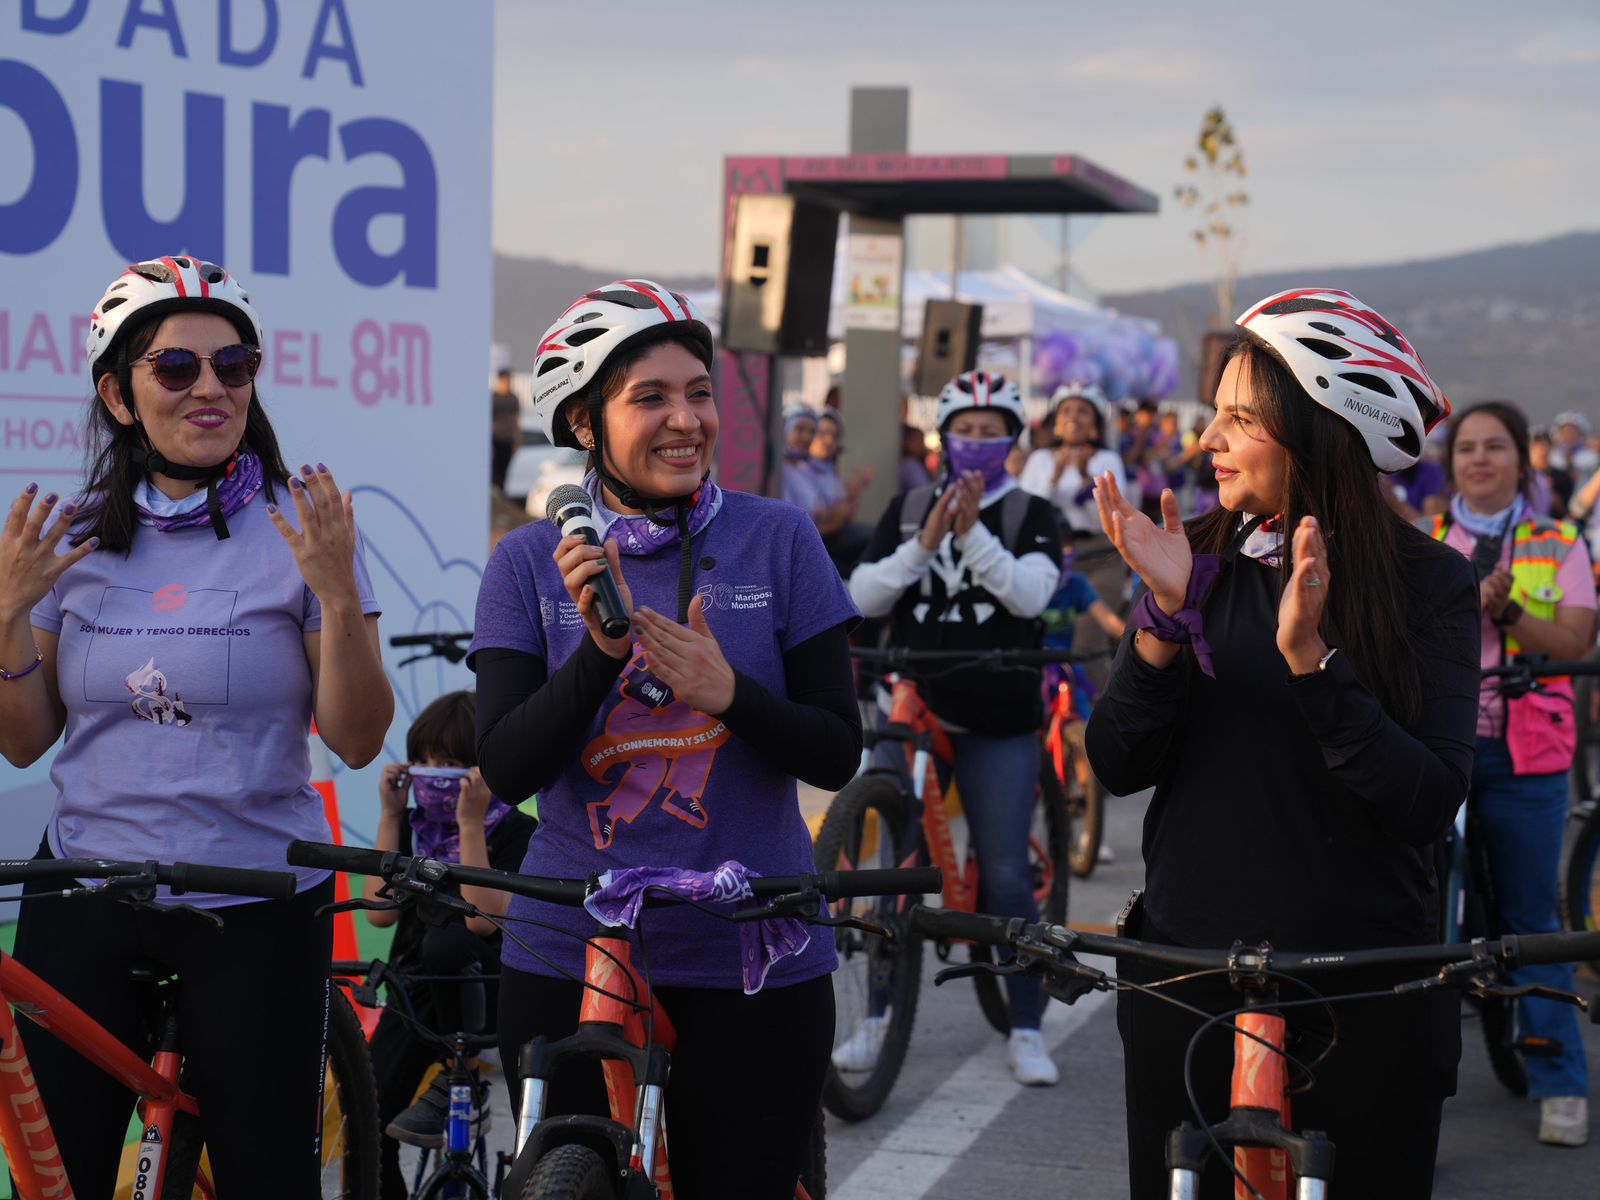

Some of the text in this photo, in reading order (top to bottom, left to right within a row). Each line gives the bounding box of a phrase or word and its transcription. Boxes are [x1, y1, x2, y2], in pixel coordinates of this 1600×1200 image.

[256, 330, 339, 390] EL
[1343, 397, 1401, 429] INNOVA RUTA
[731, 601, 768, 610] Monarca
[735, 592, 773, 602] Mariposa
[79, 625, 251, 636] SOY MUJER Y TENGO DERECHOS
[603, 746, 616, 757] SE
[616, 738, 685, 753] CONMEMORA
[685, 736, 693, 746] Y
[693, 733, 706, 745] SE
